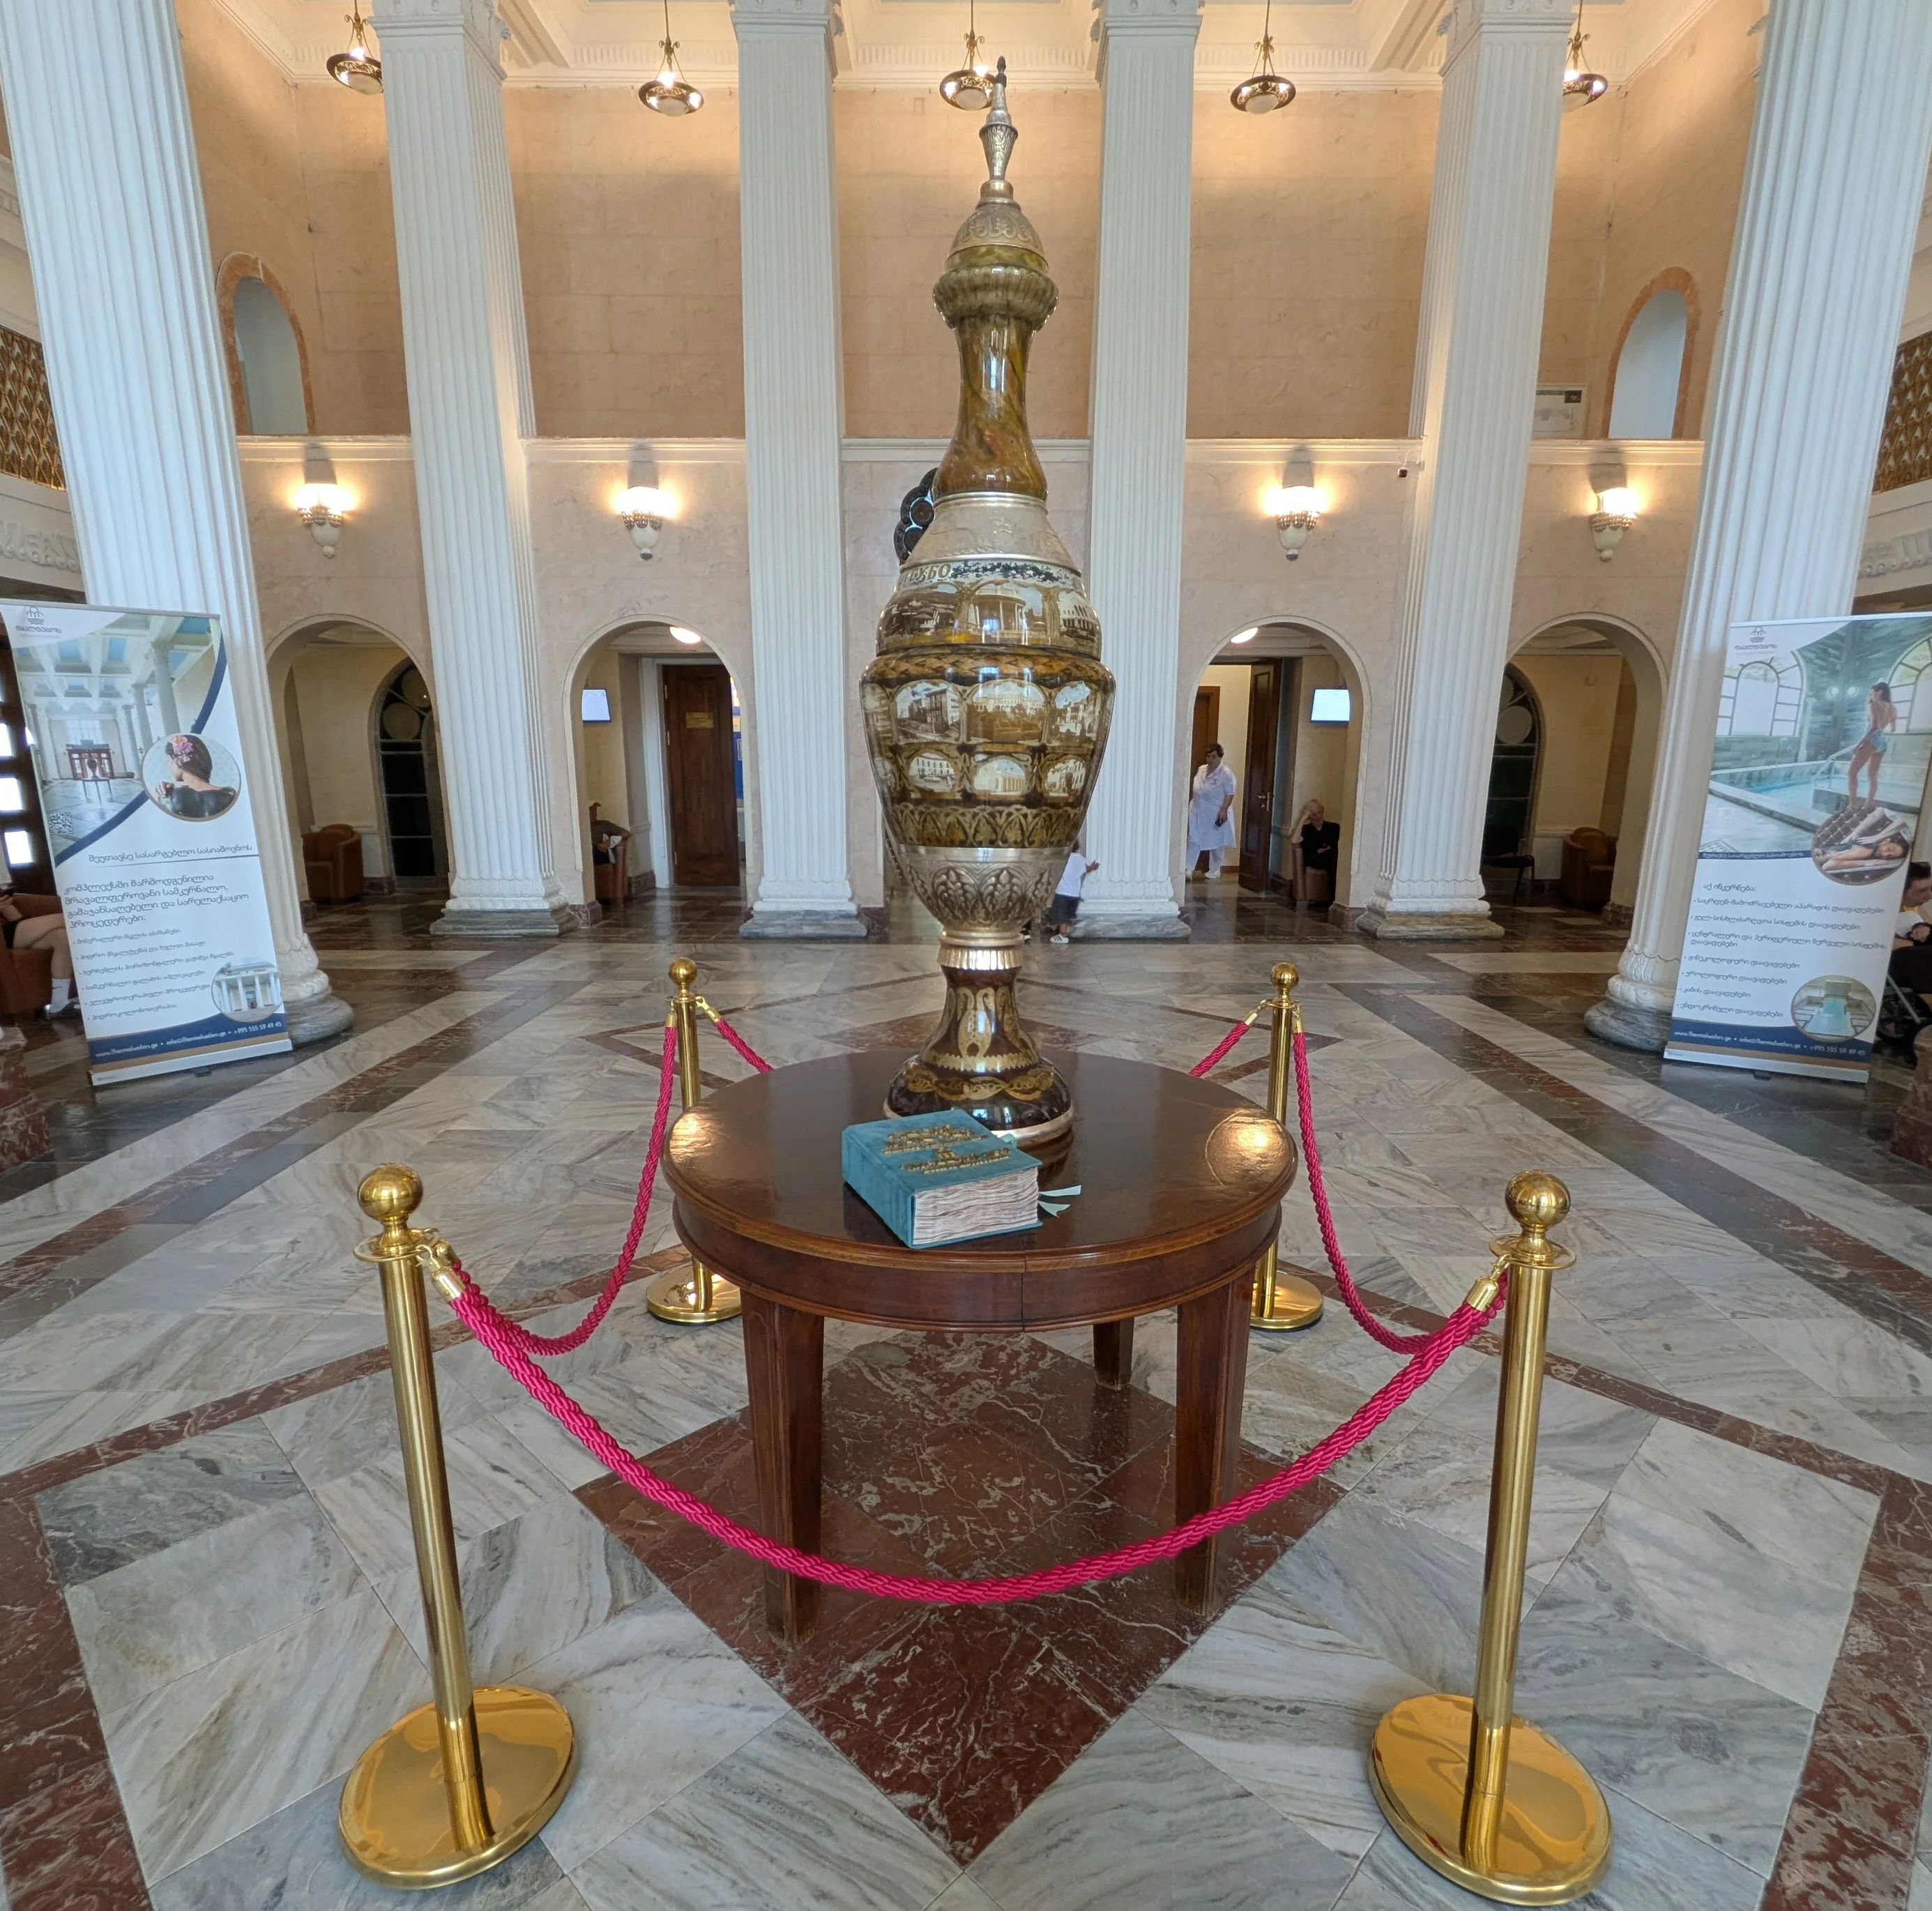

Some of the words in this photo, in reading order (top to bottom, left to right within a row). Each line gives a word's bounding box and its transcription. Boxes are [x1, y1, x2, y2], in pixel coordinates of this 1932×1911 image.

[89, 853, 133, 864] შეუთავსე
[135, 850, 195, 860] სასარგებლო
[197, 844, 252, 854] სასიამოვნოს
[63, 881, 128, 895] კომპლექსში
[130, 874, 214, 888] წარმოდგენილია
[1703, 883, 1712, 892] აქ
[65, 890, 161, 906] მრავალფეროვანი
[162, 885, 229, 897] სამკურნალო,
[67, 902, 158, 919] გამაჯანსაღებელი
[161, 901, 175, 910] და
[176, 893, 249, 906] სარელაქსაციო
[70, 915, 146, 929] პროცედურები:
